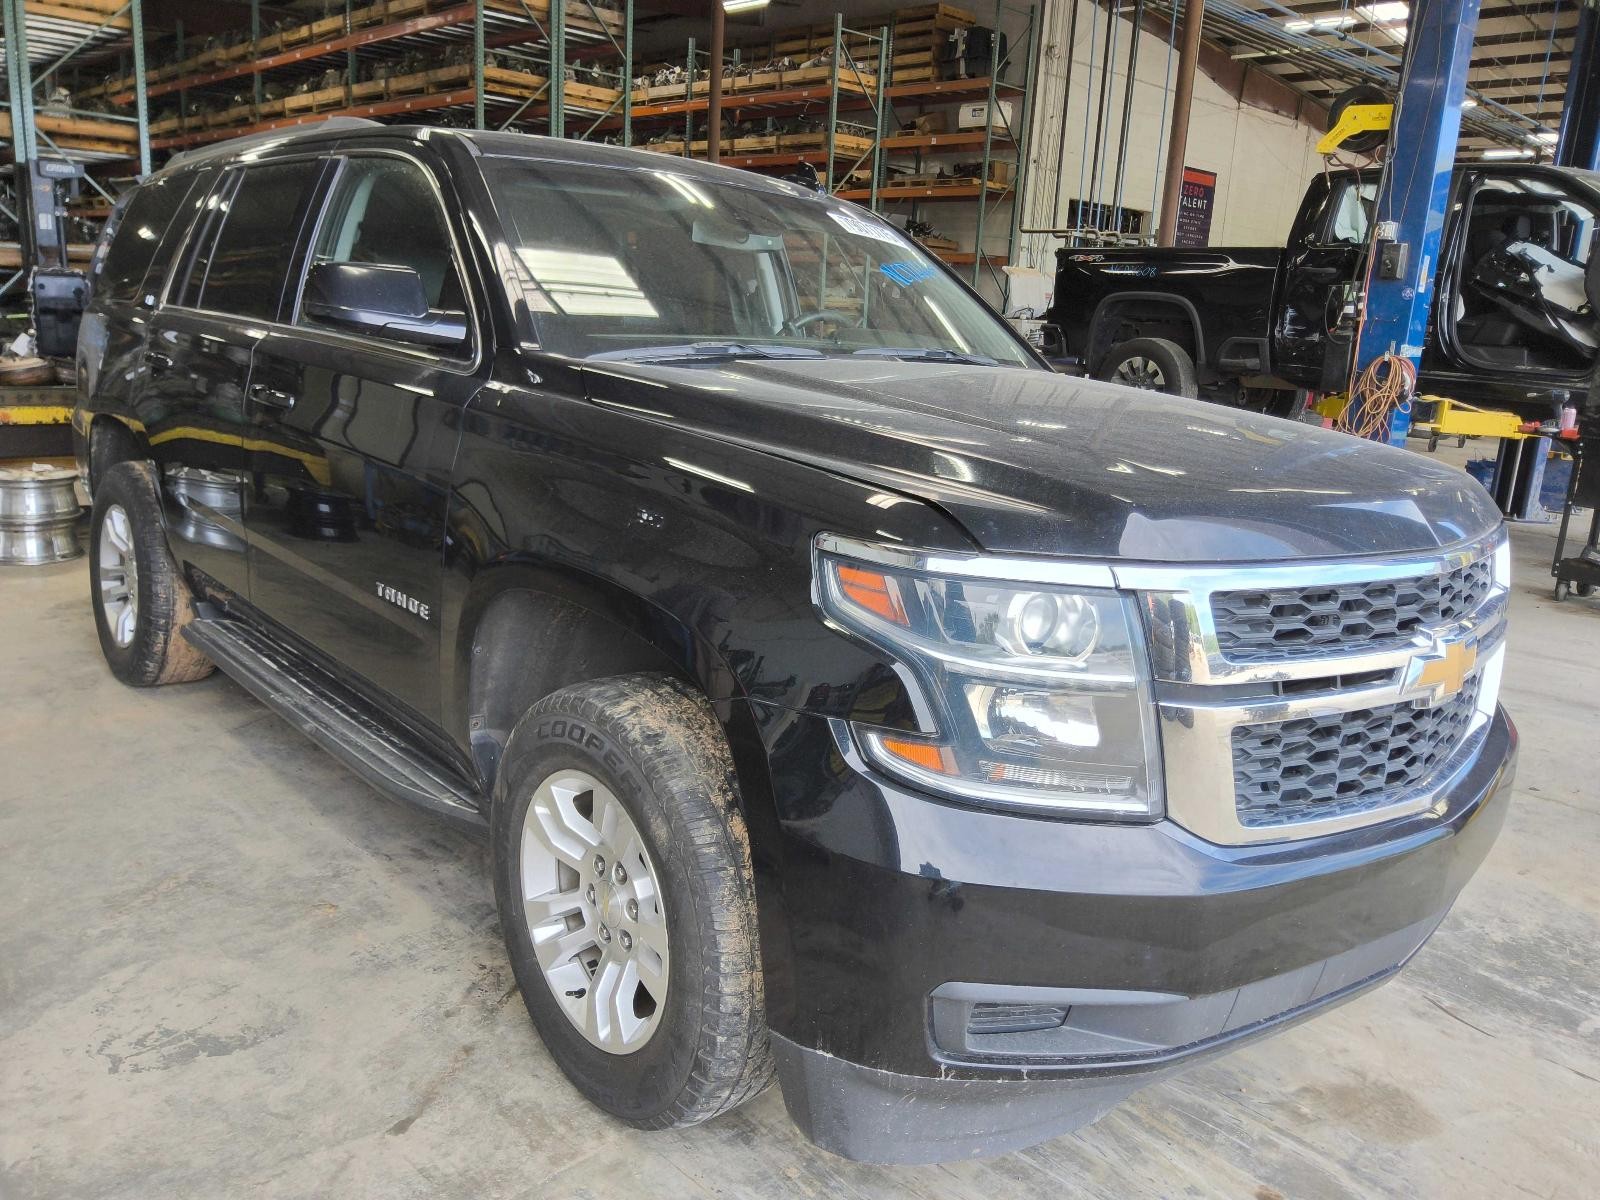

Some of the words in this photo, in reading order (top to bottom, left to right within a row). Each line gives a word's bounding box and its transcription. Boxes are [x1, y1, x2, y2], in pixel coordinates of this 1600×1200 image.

[1184, 185, 1205, 197] ZERO
[375, 581, 429, 620] TAHOE
[537, 720, 643, 797] COOPER
